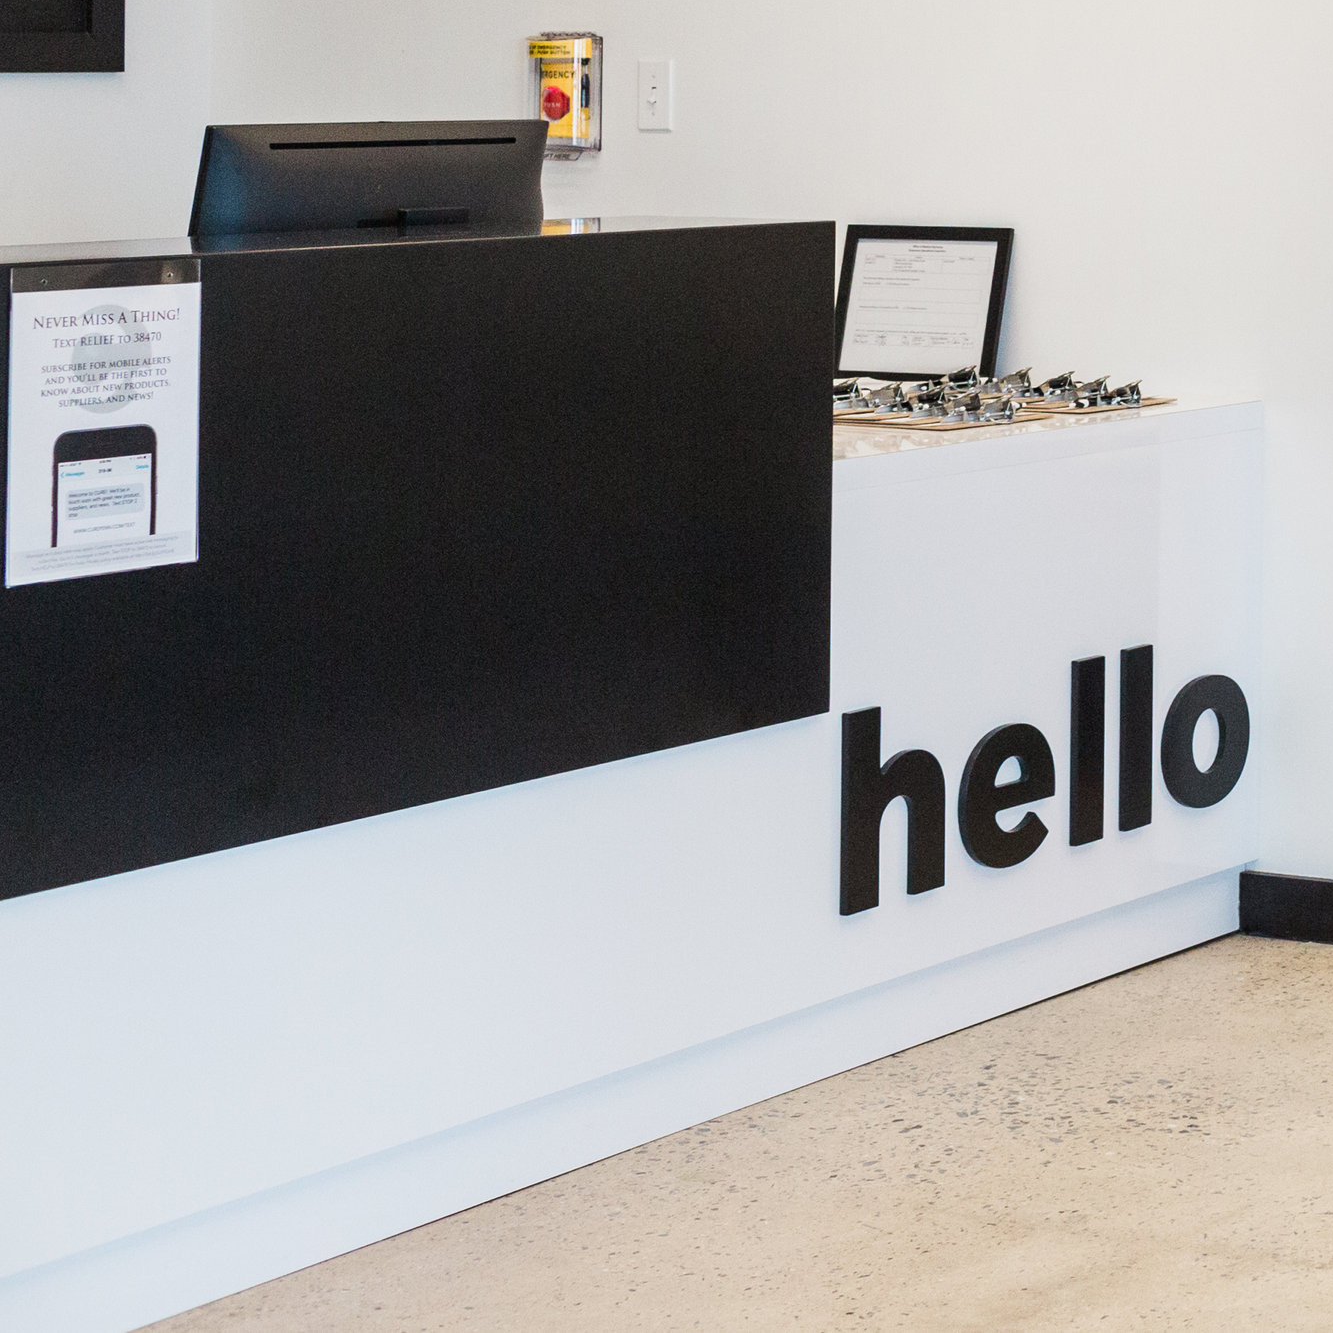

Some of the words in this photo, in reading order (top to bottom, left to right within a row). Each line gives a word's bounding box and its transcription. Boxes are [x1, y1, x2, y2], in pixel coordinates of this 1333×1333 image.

[542, 70, 574, 79] RGENCY
[118, 312, 127, 324] A
[53, 338, 77, 348] TEXT
[80, 335, 115, 346] RELIEF
[118, 334, 131, 343] TO
[134, 332, 161, 342] 38470
[41, 363, 87, 373] SUBSCRIBE
[90, 361, 107, 370] FOR
[109, 359, 140, 368] MOBILE
[142, 356, 171, 365] ALERTS
[45, 377, 65, 385] AND
[68, 374, 96, 383] YOU'LL
[99, 373, 108, 381] BE
[111, 372, 128, 380] THE
[130, 369, 152, 378] FIRST
[156, 368, 167, 376] TO
[41, 387, 68, 397] KNOW
[71, 385, 100, 395] ABOUT
[106, 395, 125, 404] AND
[128, 391, 154, 401] NEWS!
[839, 644, 1251, 917] hello
